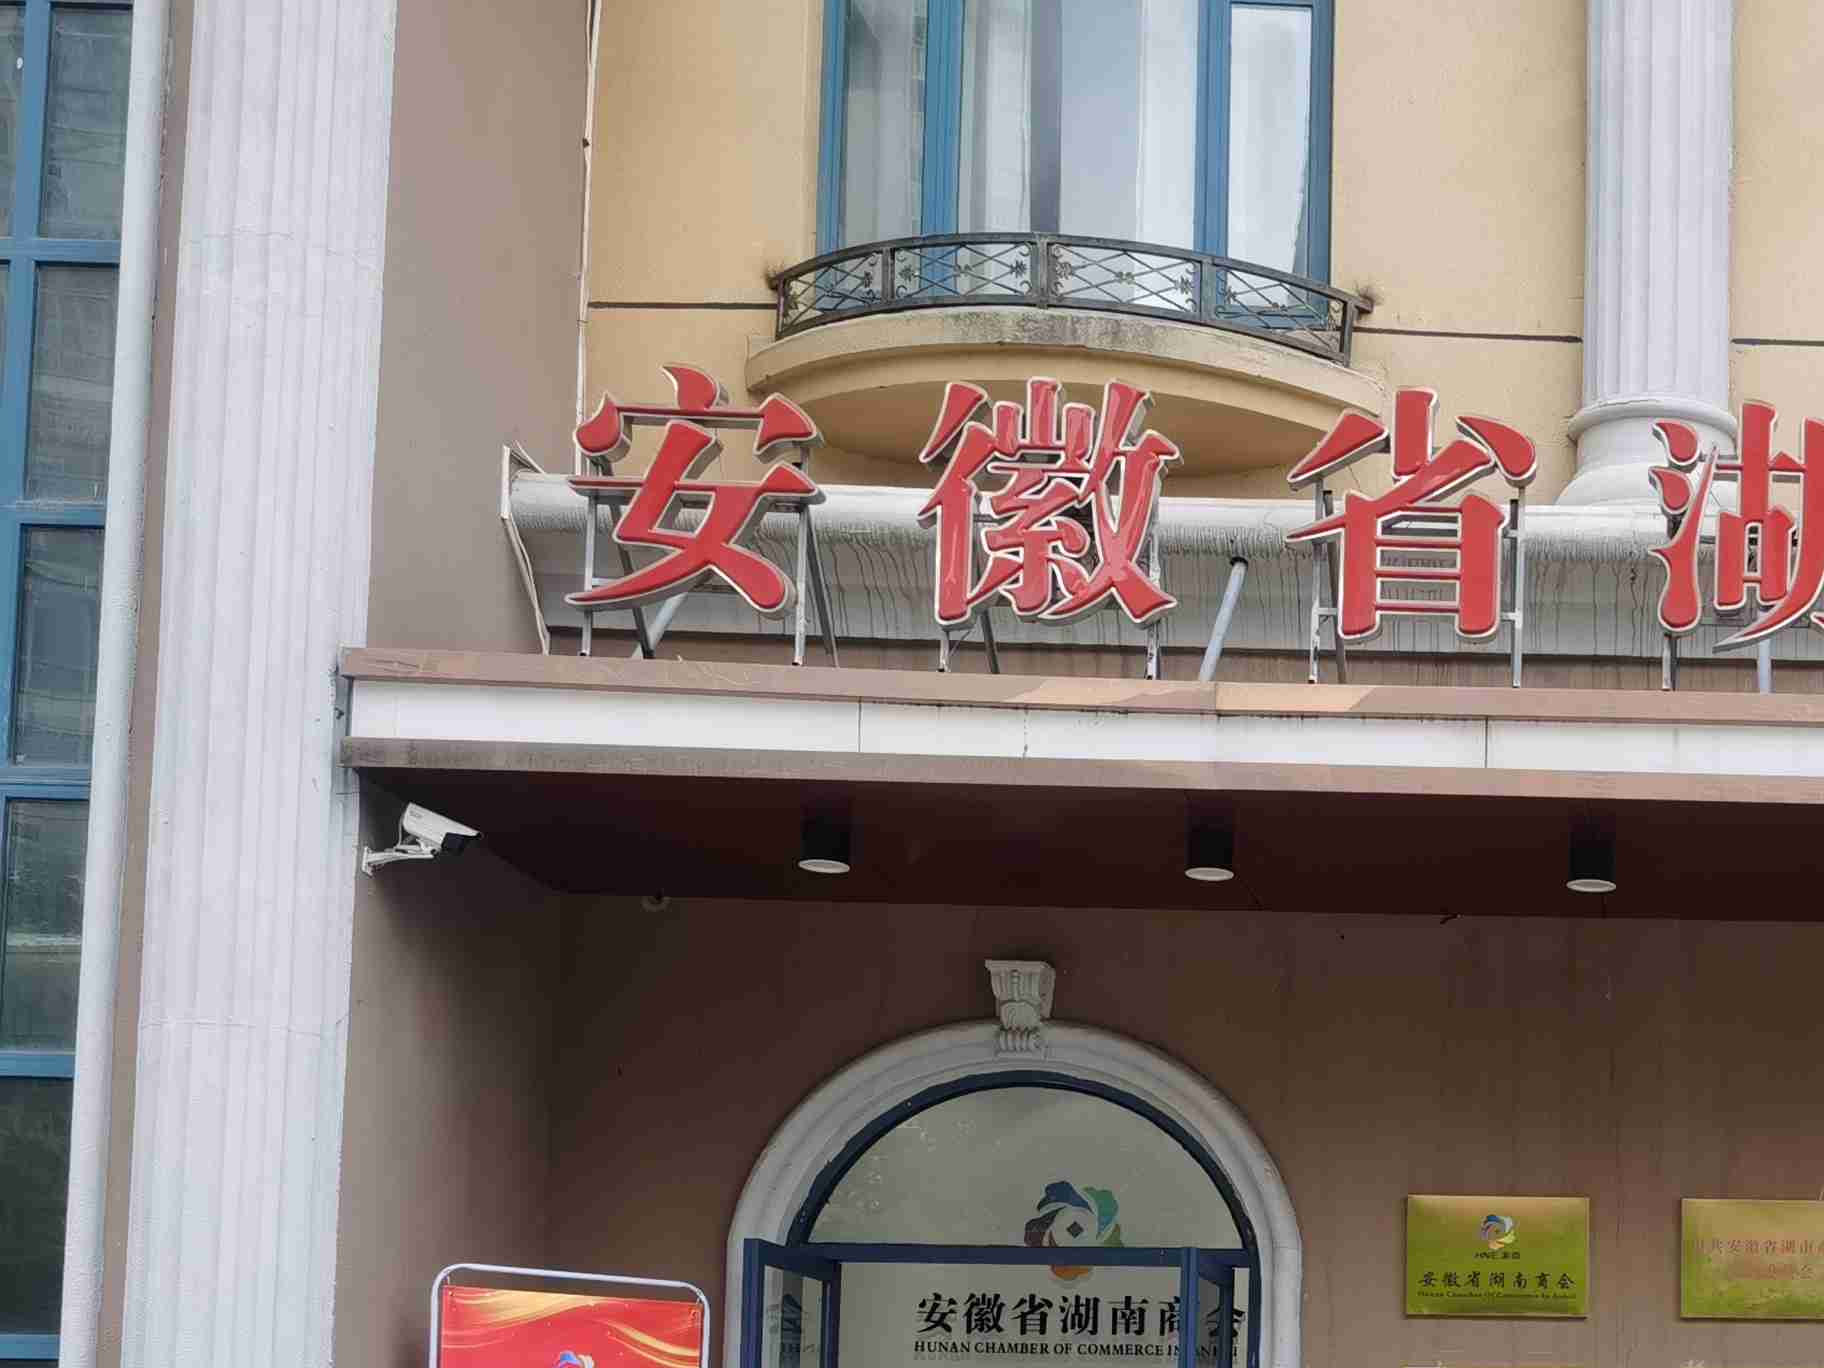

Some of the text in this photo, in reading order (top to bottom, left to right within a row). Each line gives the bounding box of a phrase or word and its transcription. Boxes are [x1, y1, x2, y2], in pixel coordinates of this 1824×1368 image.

[1417, 1270, 1576, 1290] 安徽省湖南商会
[913, 1340, 971, 1354] HUNAN
[974, 1341, 1049, 1356] CHAMBER
[1053, 1343, 1073, 1356] OF
[1076, 1343, 1163, 1357] COMMERCE
